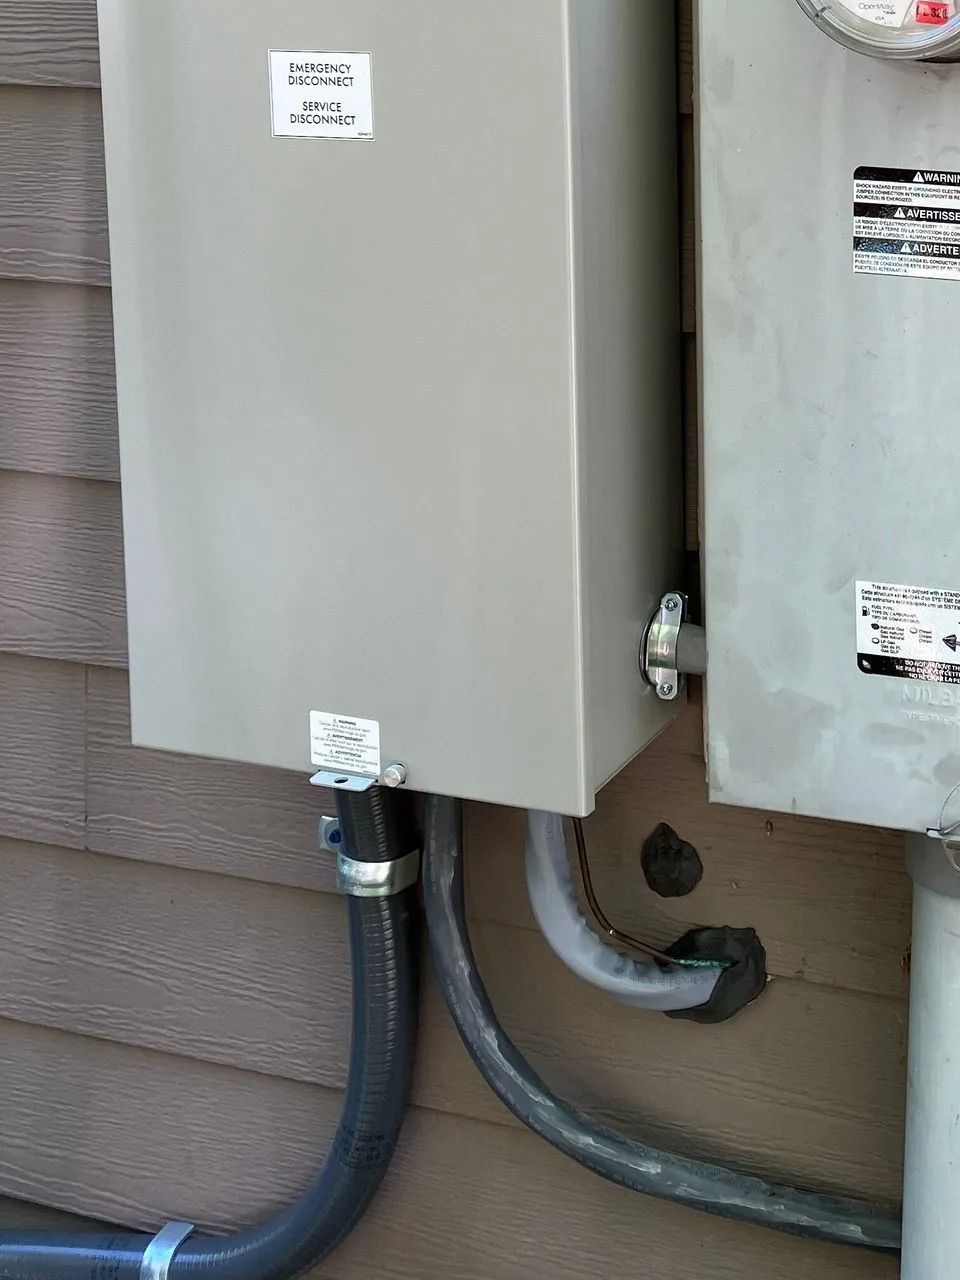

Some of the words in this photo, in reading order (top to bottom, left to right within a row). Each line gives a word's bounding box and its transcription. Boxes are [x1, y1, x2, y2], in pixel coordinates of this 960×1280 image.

[858, 2, 895, 10] OpenWay
[289, 62, 352, 74] EMERGENCY
[288, 76, 354, 86] DISCONNECT
[302, 101, 342, 112] SERVICE
[290, 114, 356, 125] DISCONNECT
